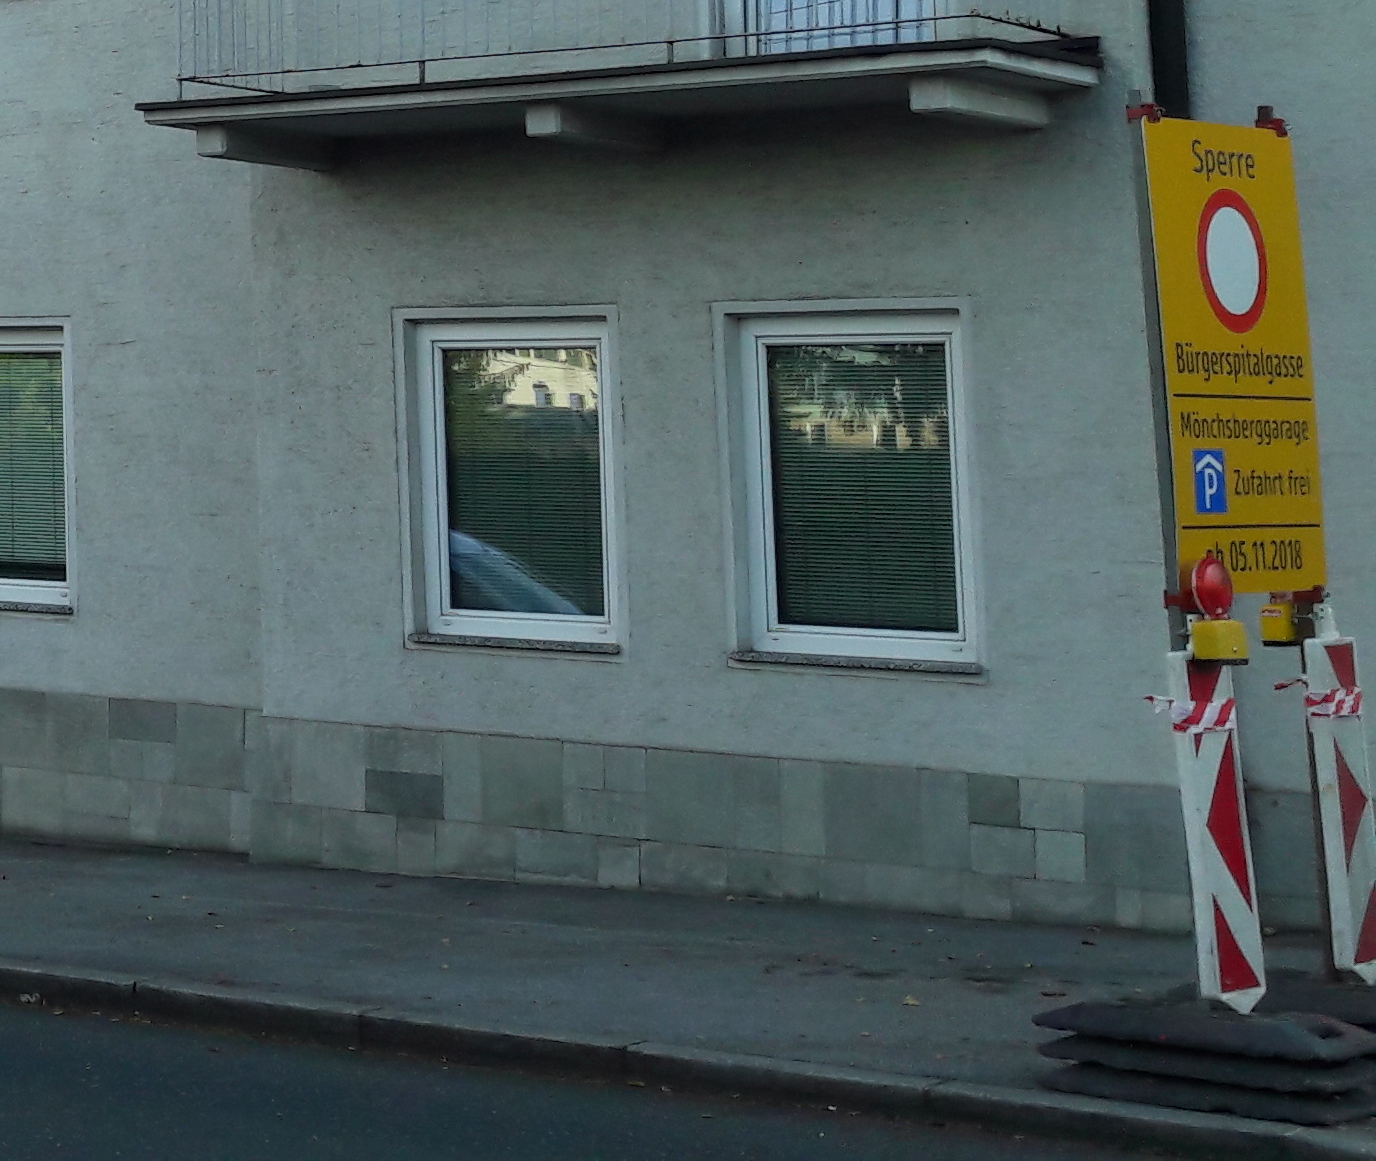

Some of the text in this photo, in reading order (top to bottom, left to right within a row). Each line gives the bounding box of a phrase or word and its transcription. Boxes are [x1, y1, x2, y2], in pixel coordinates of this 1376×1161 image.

[1191, 138, 1256, 179] Sperre
[1175, 341, 1304, 385] Bürgerspitalgasse
[1180, 410, 1311, 445] Mönchsberggarage
[1233, 469, 1284, 496] Zufahrt
[1287, 468, 1312, 497] frei
[1229, 540, 1303, 571] 05.11.2018
